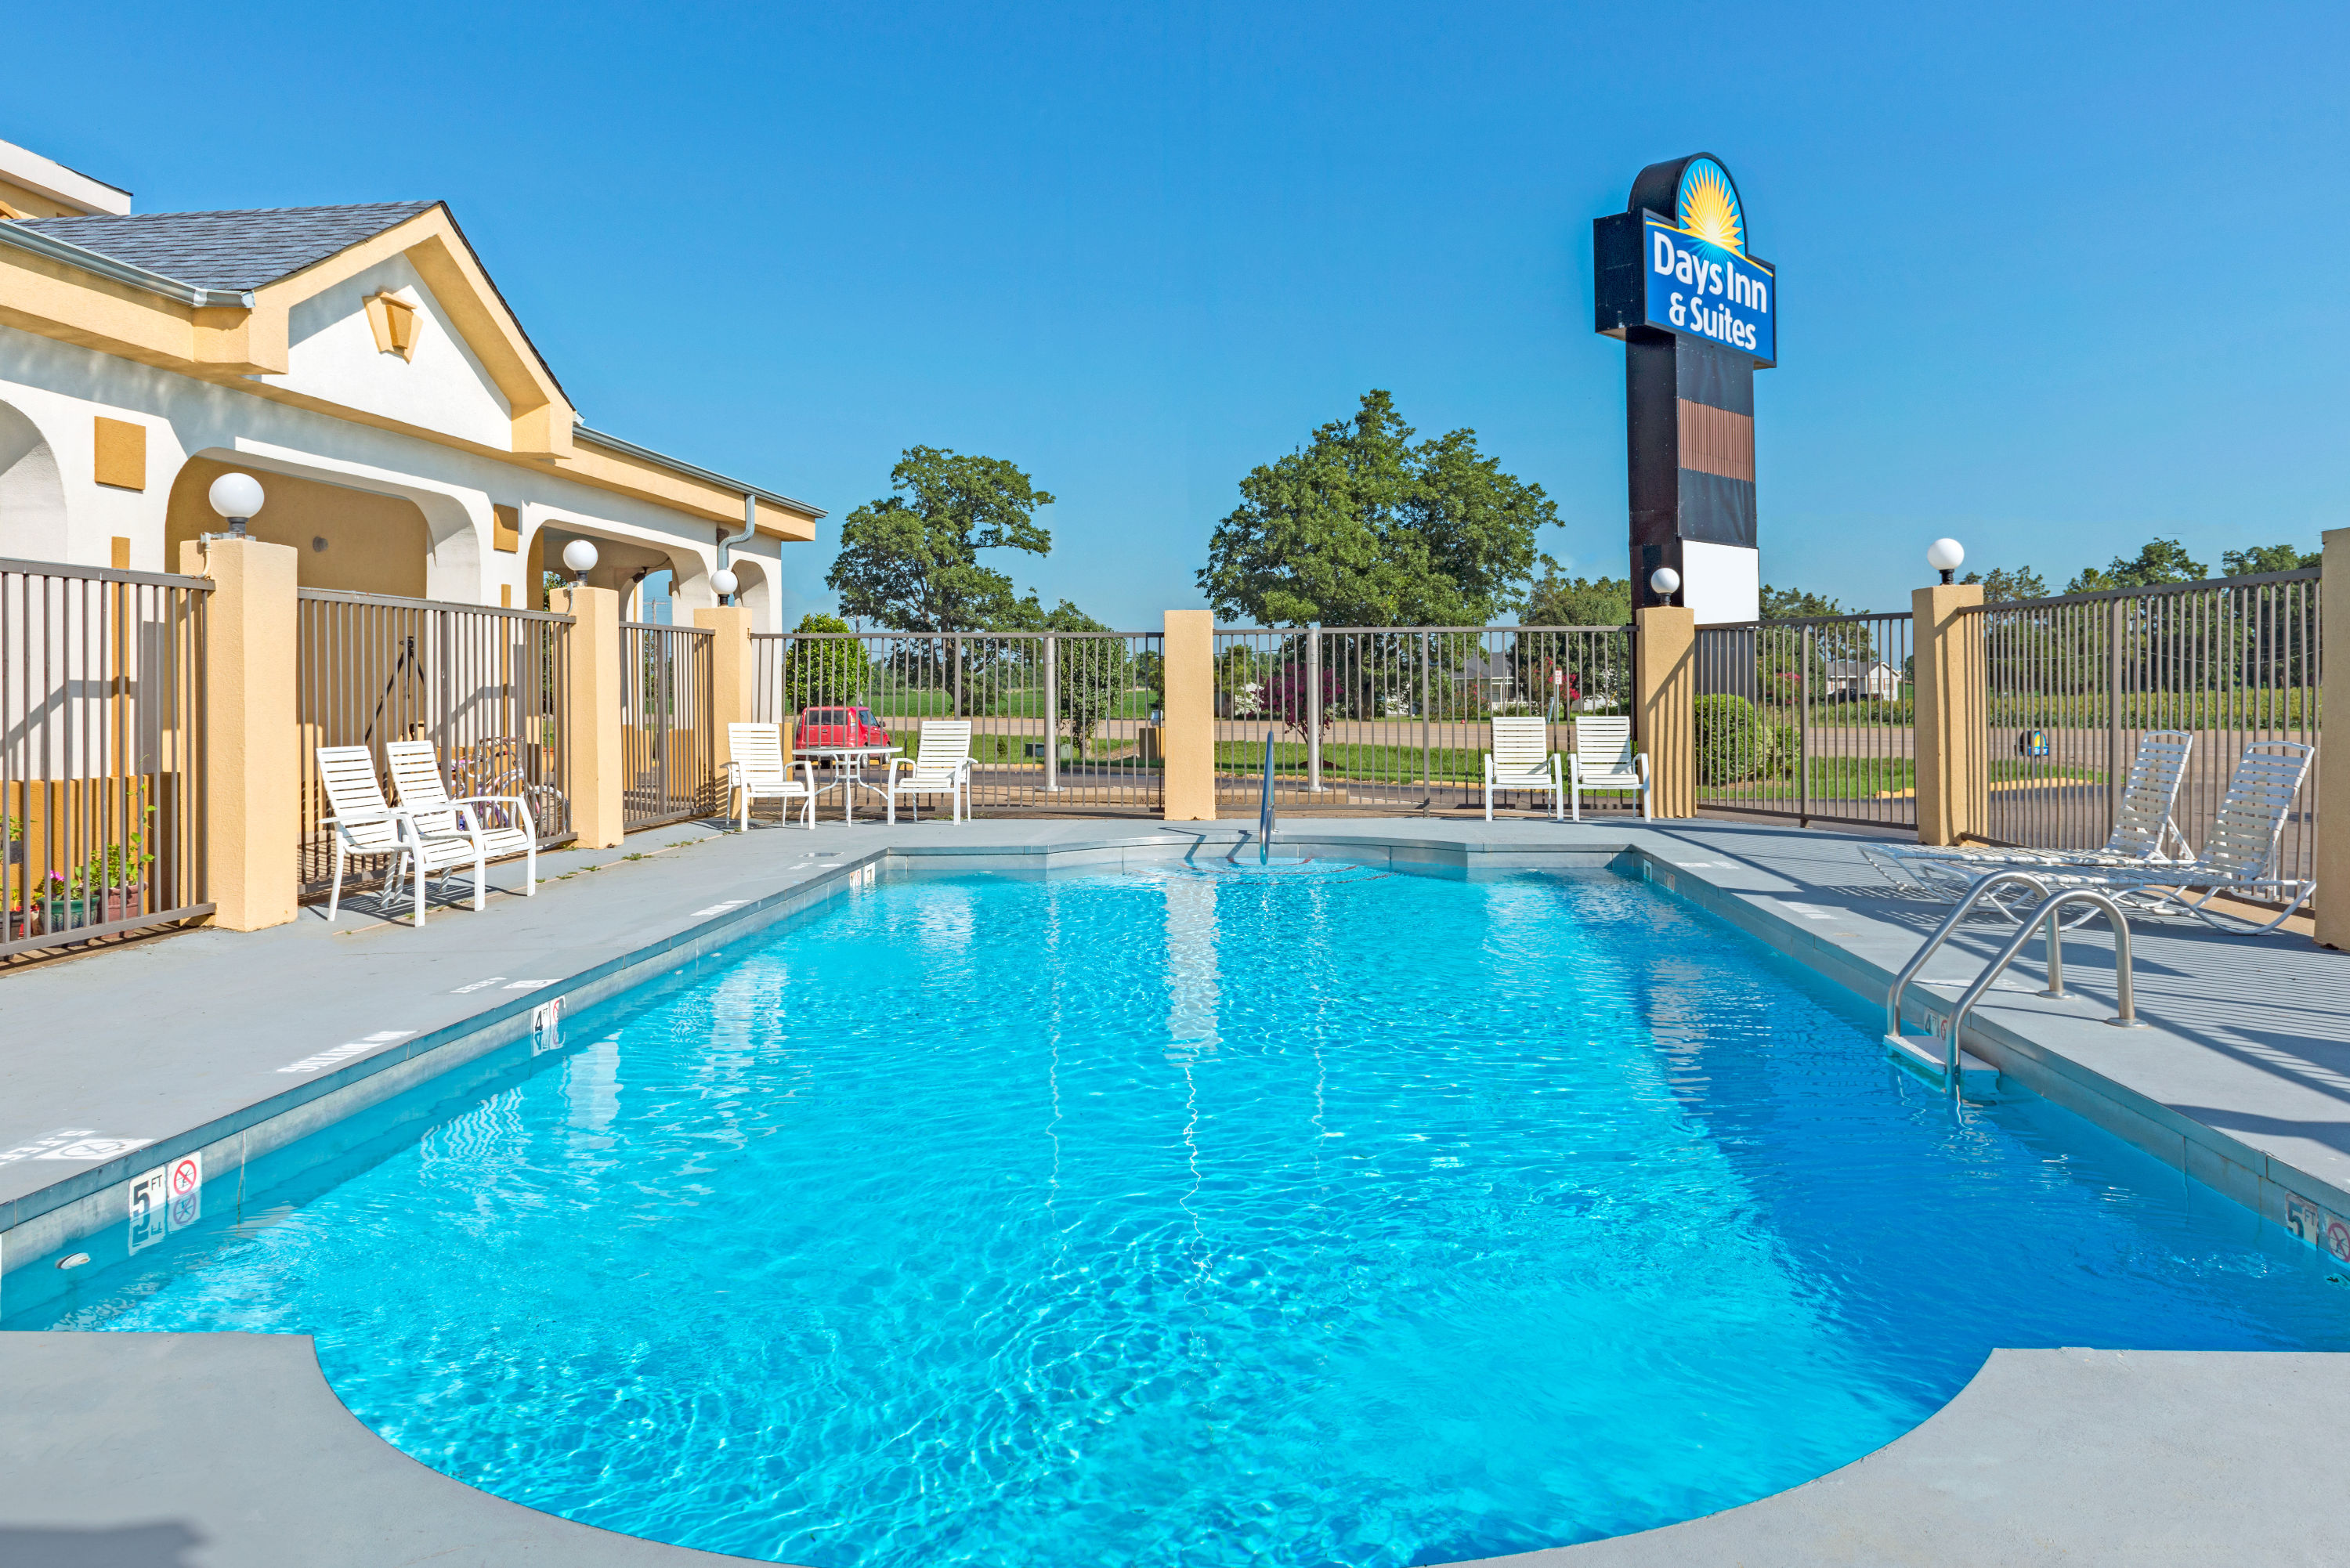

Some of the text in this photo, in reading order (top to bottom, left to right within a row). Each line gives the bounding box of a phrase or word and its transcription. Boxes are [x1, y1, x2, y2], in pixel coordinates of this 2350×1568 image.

[1654, 230, 1767, 313] Days Inn
[1668, 292, 1757, 351] & Suites
[132, 1174, 163, 1218] 5 FT
[2287, 1200, 2316, 1239] 5 FT
